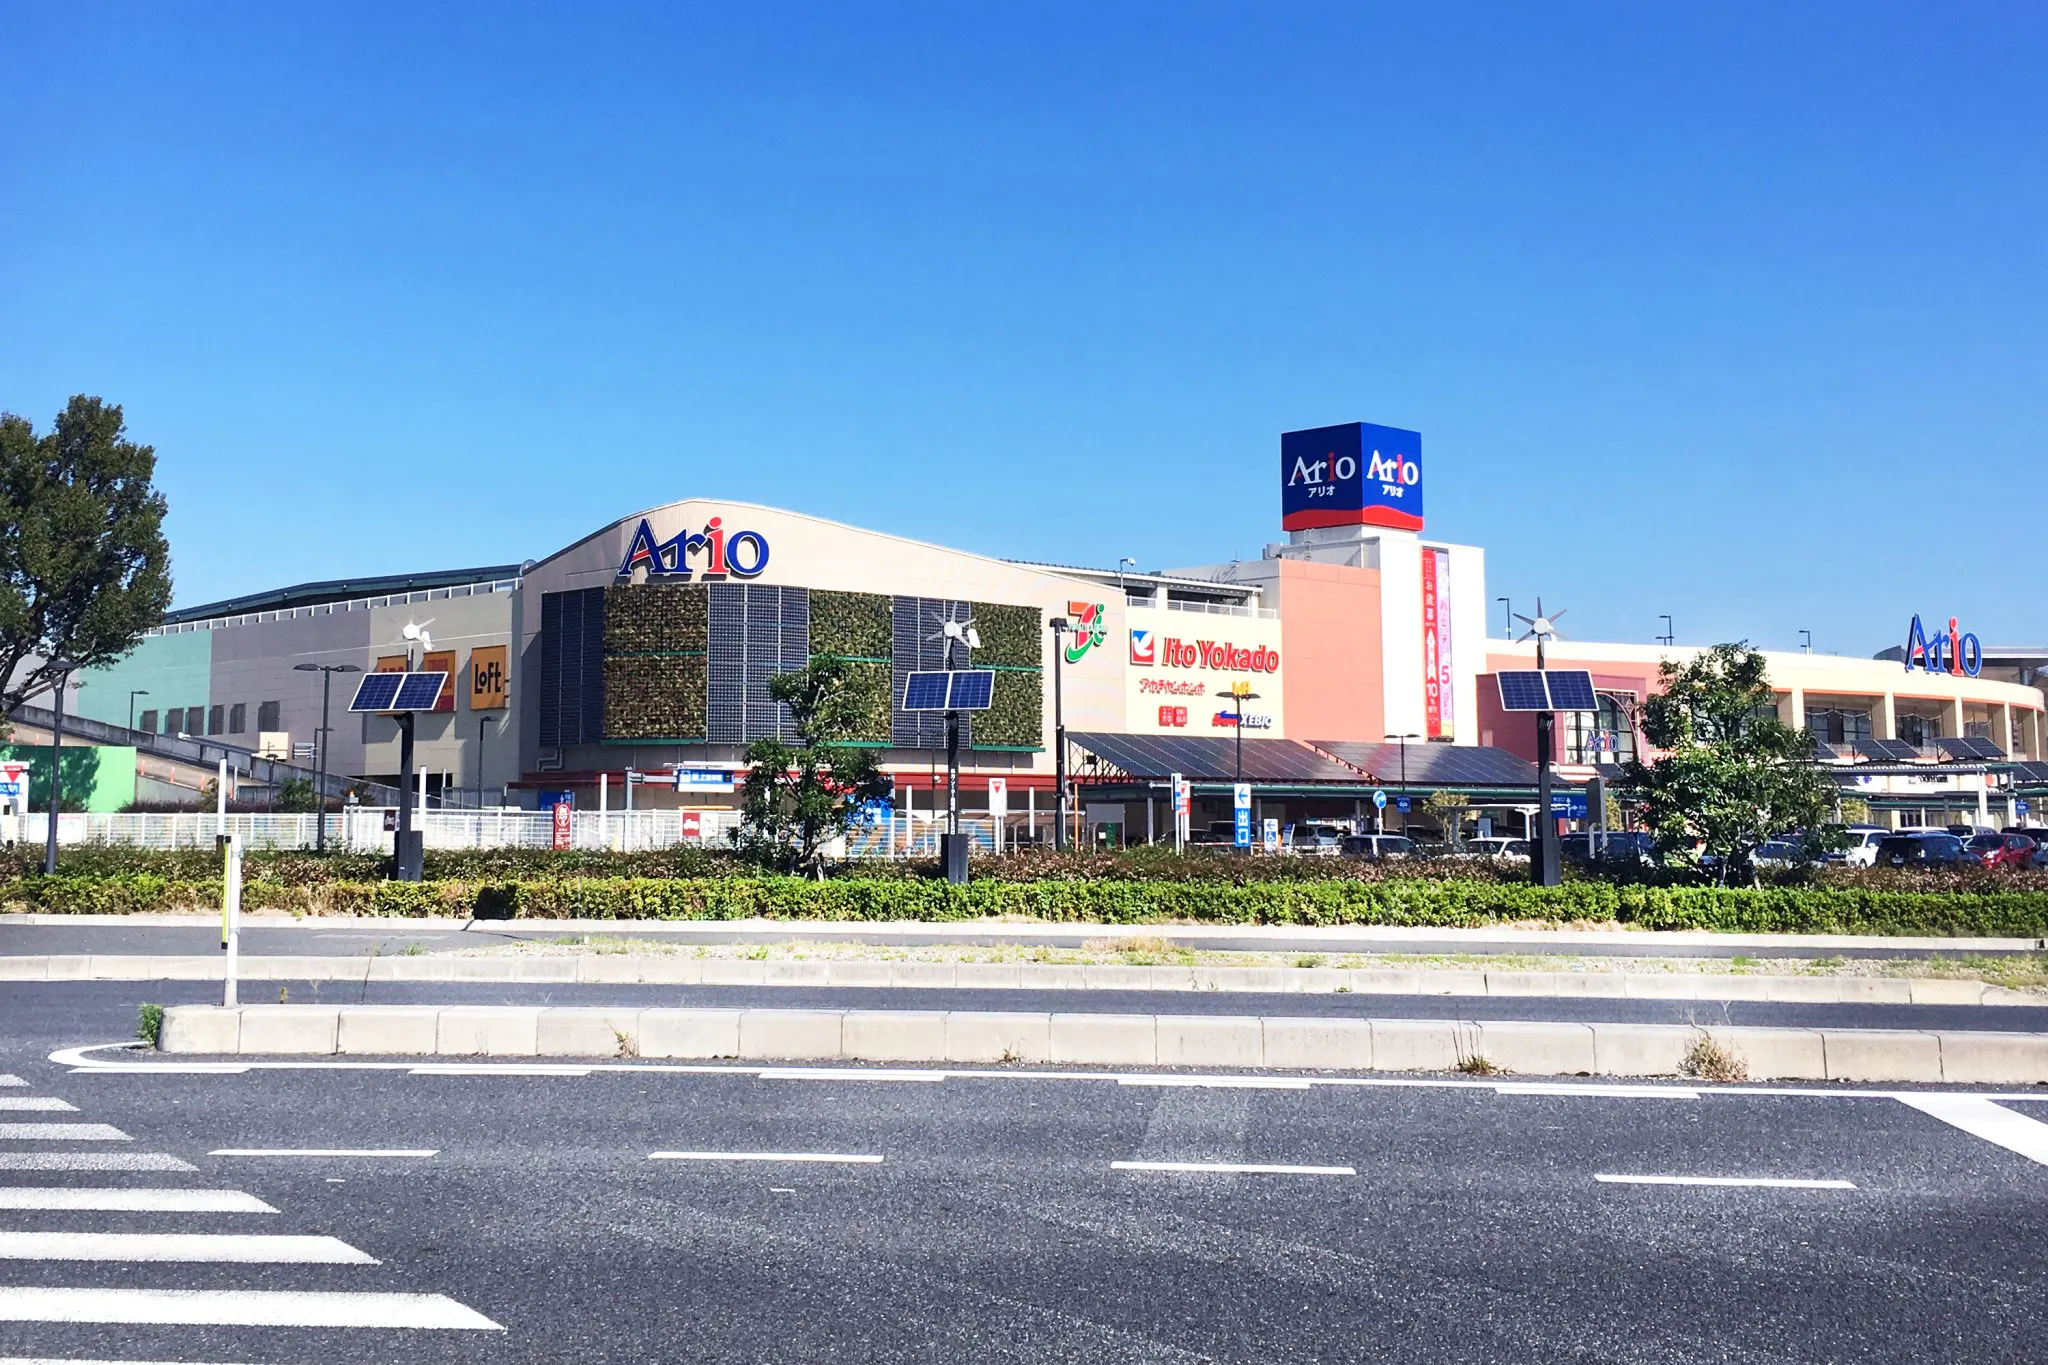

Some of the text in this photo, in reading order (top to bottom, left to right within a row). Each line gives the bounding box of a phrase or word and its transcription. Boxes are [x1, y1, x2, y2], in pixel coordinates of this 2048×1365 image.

[1288, 451, 1356, 487] Ario
[1366, 449, 1419, 486] Ario
[1308, 485, 1336, 498] アリオ
[1382, 484, 1404, 498] アリオ
[618, 516, 770, 576] Ario
[1162, 637, 1280, 673] Ito Yokado
[1904, 612, 1983, 678] Ario
[474, 661, 501, 694] Loft
[1239, 713, 1272, 727] XEBIO
[1585, 729, 1619, 752] Ario
